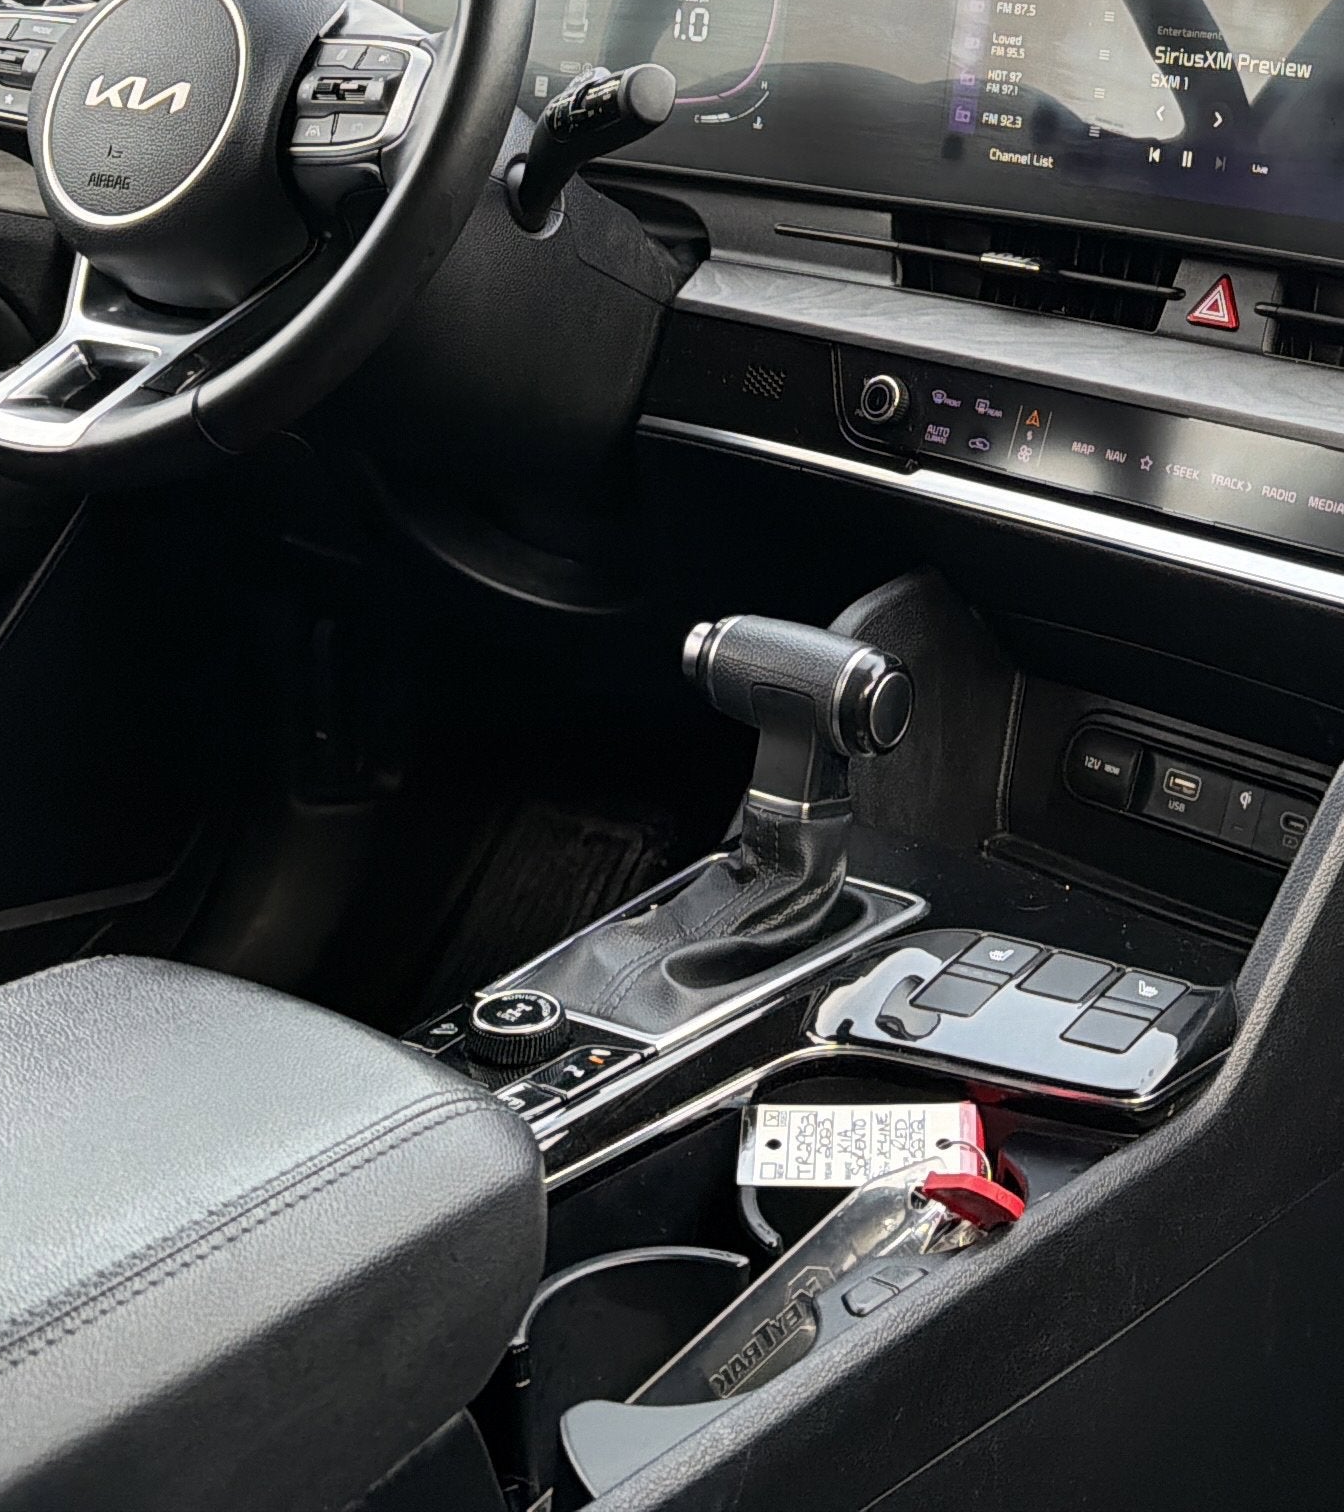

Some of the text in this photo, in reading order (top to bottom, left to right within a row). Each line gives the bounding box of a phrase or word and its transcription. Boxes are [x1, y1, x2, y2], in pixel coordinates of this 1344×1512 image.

[997, 1, 1037, 16] FM 87.5
[673, 7, 710, 42] 1.0
[1157, 25, 1223, 41] Entertainment
[992, 33, 1022, 45] Loved
[990, 45, 1025, 59] FM 95.5
[1155, 45, 1313, 79] SiriusXM Preview
[987, 69, 1022, 84] HOT 97
[1151, 73, 1189, 90] SXM 1
[83, 74, 192, 115] KIA
[985, 83, 1018, 96] FM 97.1
[982, 112, 1022, 129] FM 92.3
[989, 147, 1054, 169] Channel List
[1251, 163, 1269, 175] Live
[87, 172, 131, 191] AIRBAG
[927, 424, 950, 438] AUTO
[1071, 440, 1095, 456] MAP
[1106, 448, 1127, 464] NAV
[1173, 464, 1200, 480] SEEK
[1211, 473, 1245, 492] TRACK
[1261, 485, 1297, 504] RADIO
[1084, 755, 1102, 771] 12V
[1168, 799, 1186, 813] USB
[837, 1129, 852, 1154] KIA
[891, 1119, 908, 1151] RED
[795, 1112, 816, 1178] TR2953
